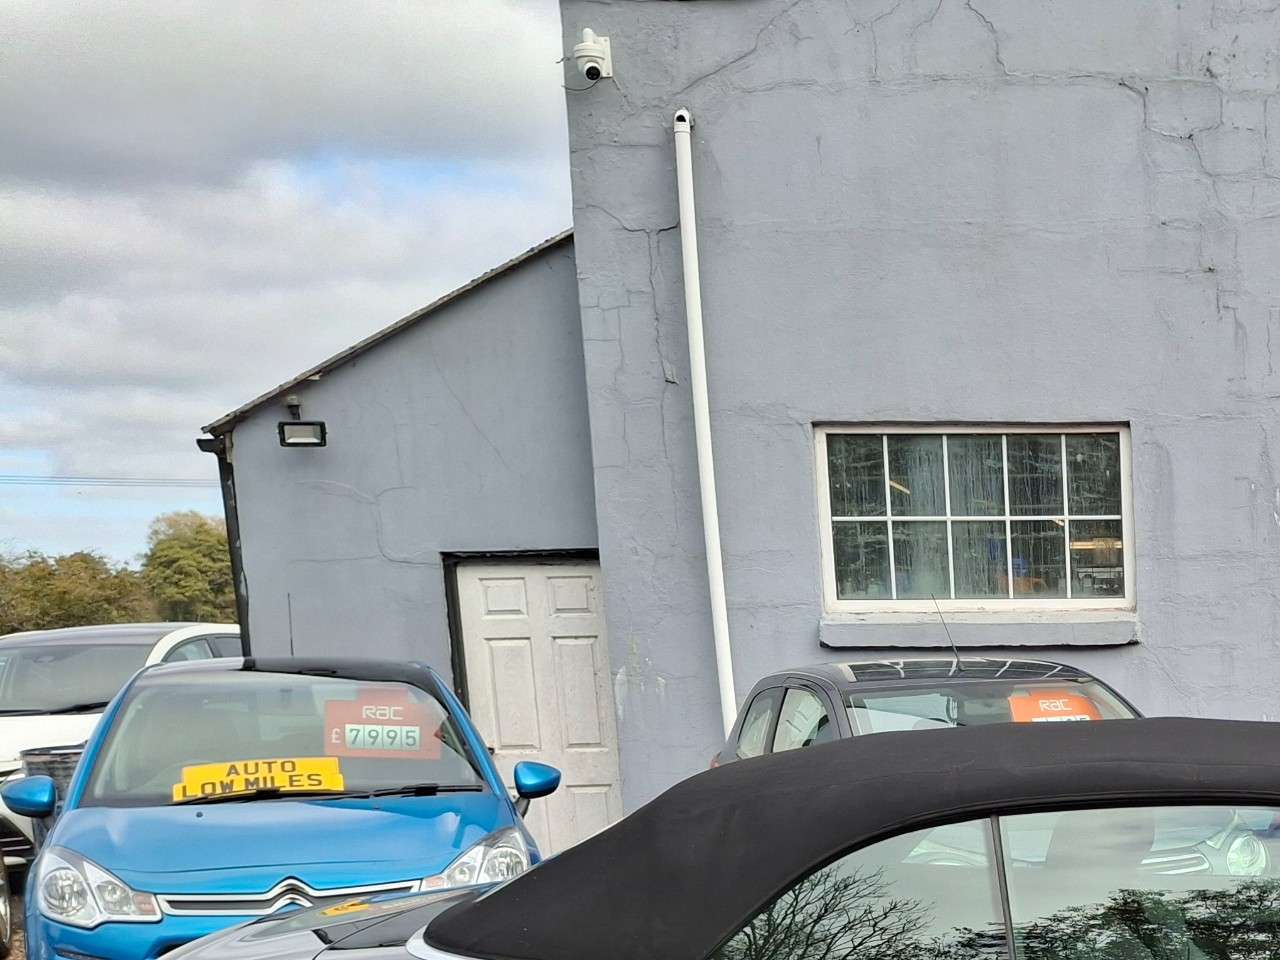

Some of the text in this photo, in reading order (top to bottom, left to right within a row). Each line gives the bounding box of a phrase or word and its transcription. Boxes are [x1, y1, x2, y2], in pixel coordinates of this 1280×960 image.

[225, 759, 297, 778] AUTO
[181, 773, 323, 800] LOW MILES
